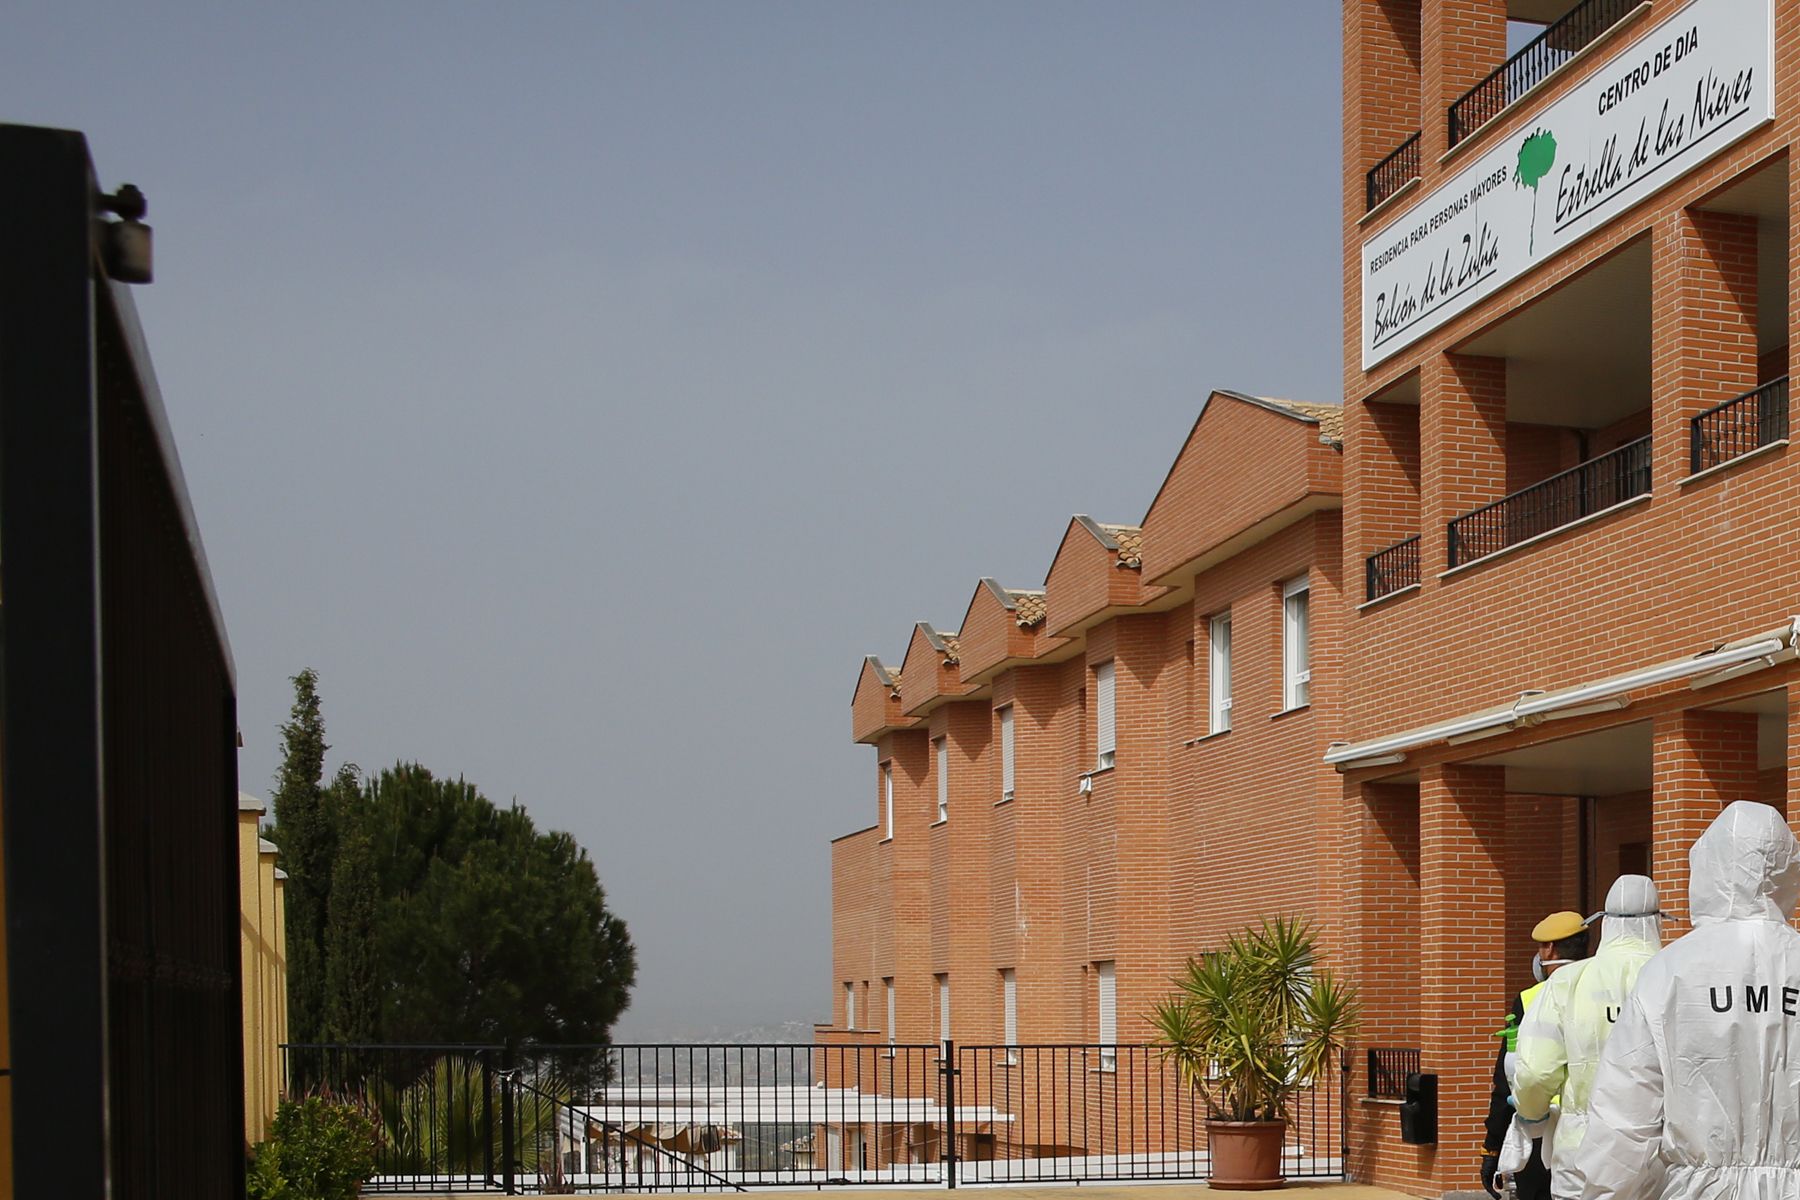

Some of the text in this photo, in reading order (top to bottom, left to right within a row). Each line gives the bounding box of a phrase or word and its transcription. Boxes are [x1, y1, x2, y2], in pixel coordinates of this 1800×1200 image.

[1598, 25, 1698, 116] CENTRO DE DIA
[1556, 66, 1753, 223] Estrella de las Nieves
[1370, 165, 1507, 275] RESIDENCIA PARA PERSONAS MAYORES
[1373, 221, 1499, 344] Balcón de la Zubia
